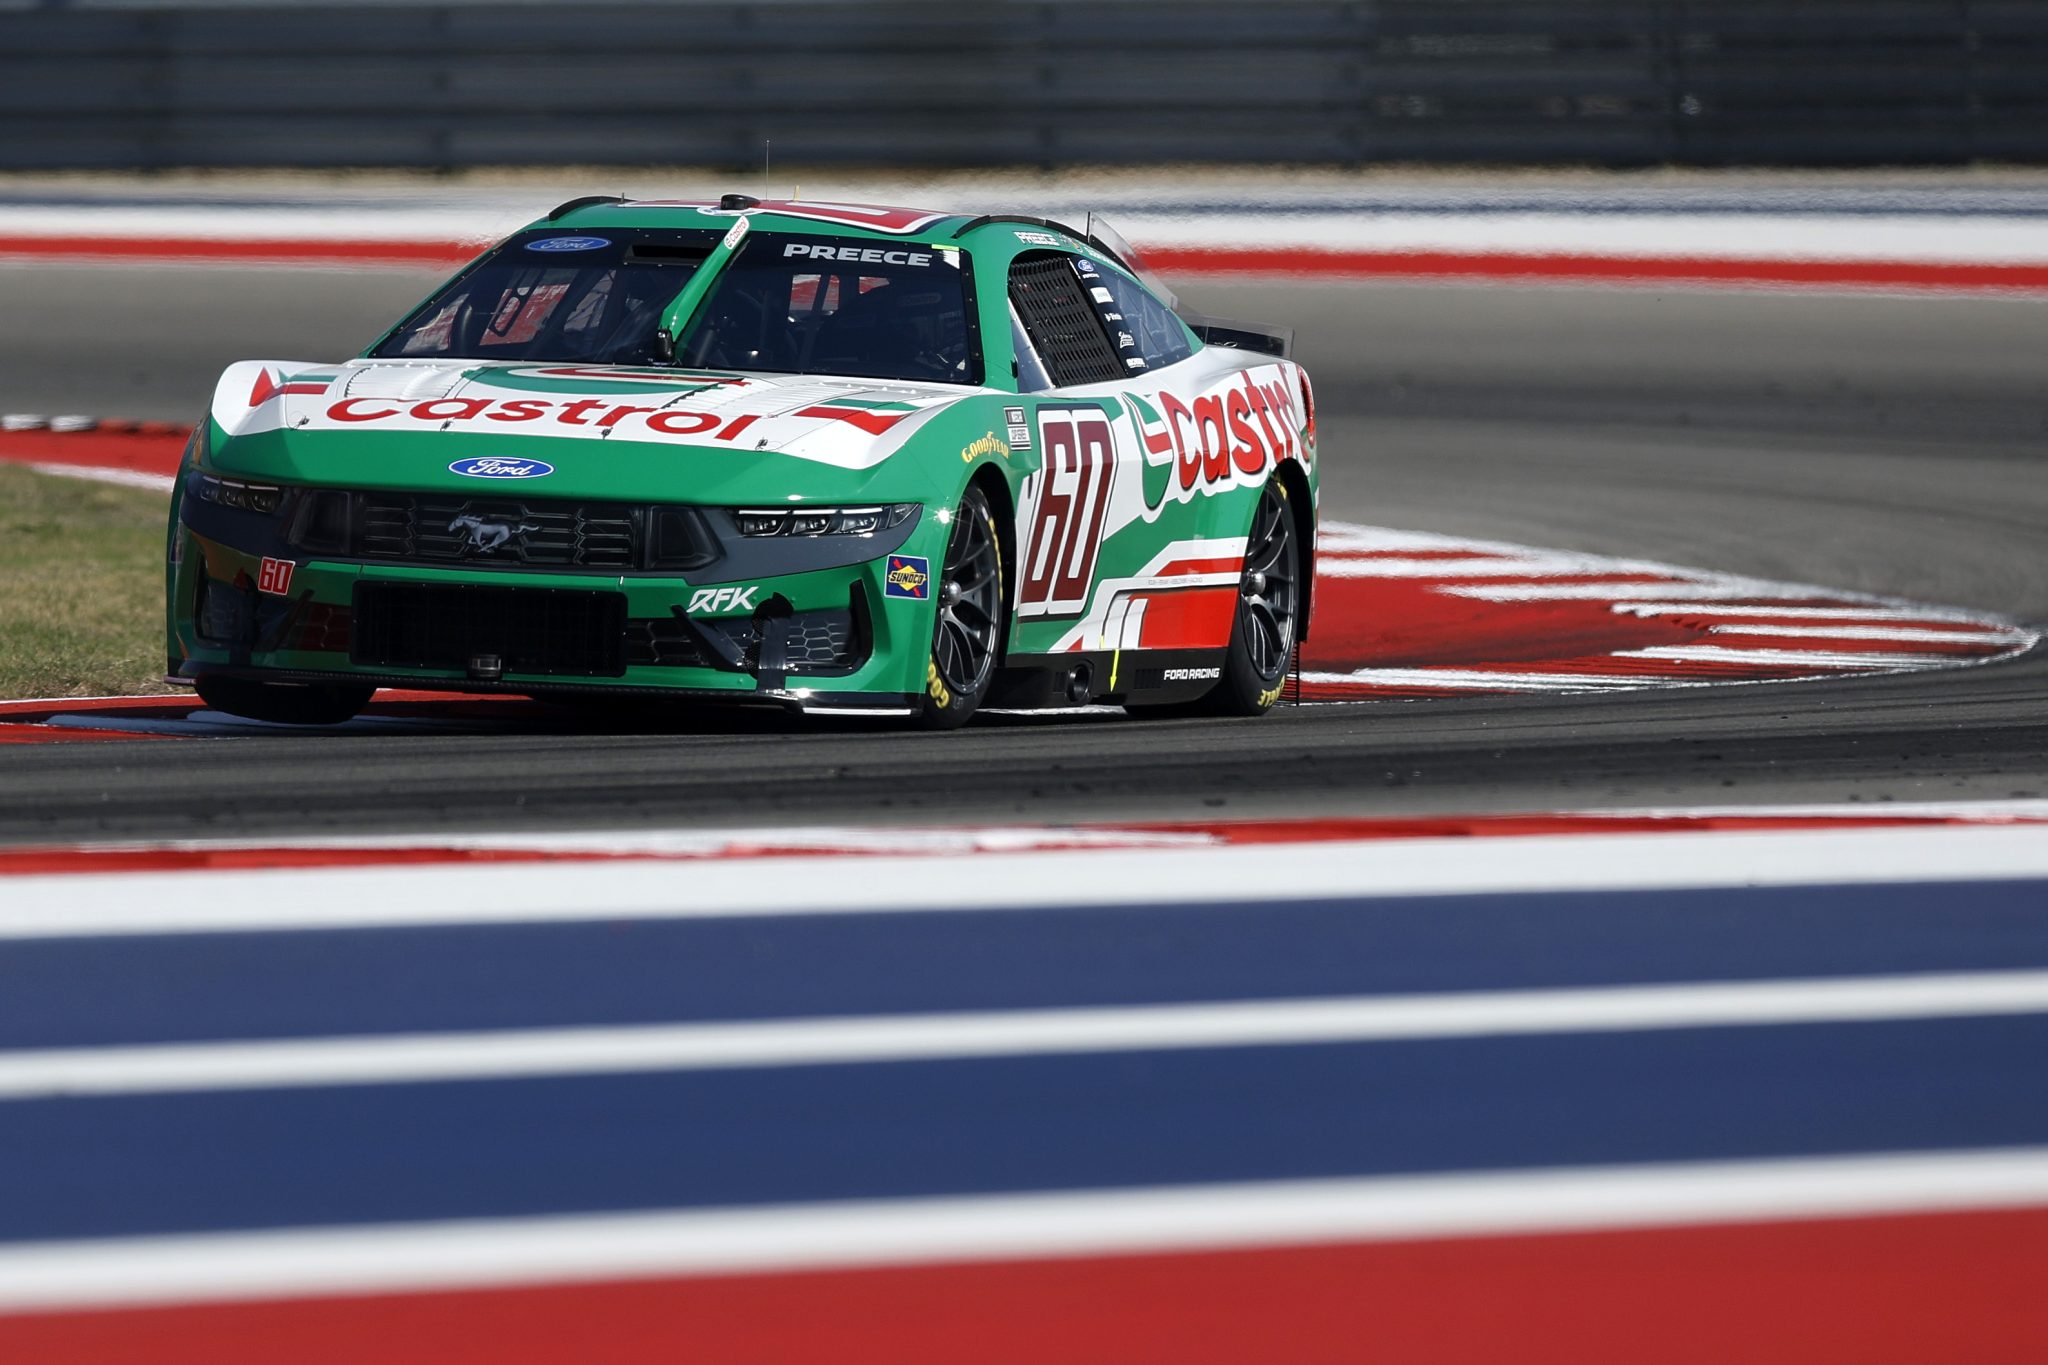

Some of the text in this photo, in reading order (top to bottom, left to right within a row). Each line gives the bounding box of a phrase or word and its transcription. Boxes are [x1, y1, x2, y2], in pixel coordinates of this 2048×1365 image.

[729, 218, 748, 243] Castrol
[540, 238, 597, 250] Ford
[783, 243, 933, 267] PREECE
[326, 397, 762, 441] Castrol
[961, 436, 1009, 463] GOODYEAR
[466, 459, 535, 476] Ford
[1019, 418, 1115, 606] 60
[259, 558, 294, 594] 60
[889, 571, 925, 585] SUNOCO
[686, 586, 759, 613] RFK
[1163, 667, 1220, 681] FORD RACING
